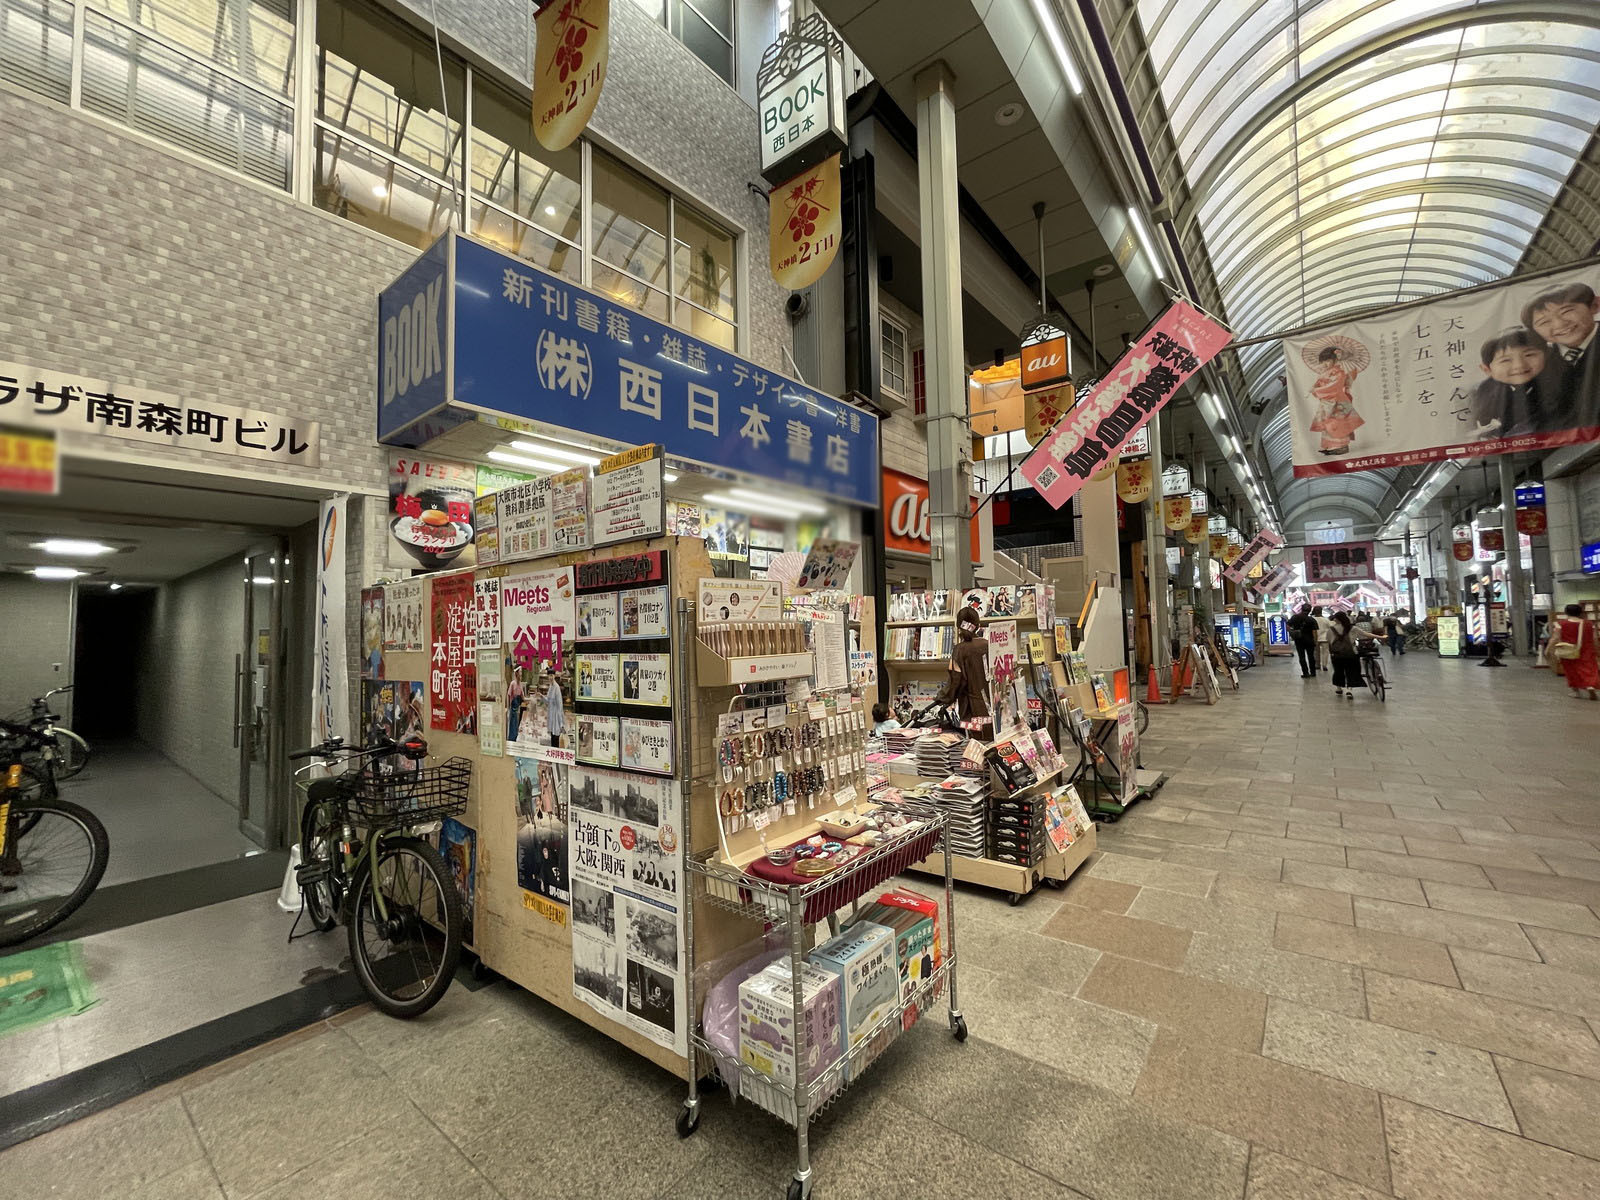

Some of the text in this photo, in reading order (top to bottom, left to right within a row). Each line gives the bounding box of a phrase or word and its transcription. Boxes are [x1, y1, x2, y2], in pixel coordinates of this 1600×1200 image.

[764, 72, 825, 134] BOOK
[773, 114, 815, 152] 西日本
[776, 233, 835, 271] 天神橋2丁目
[384, 274, 442, 406] BOOK
[502, 267, 862, 434] 新刊書籍・雑誌・デザイン書洋書
[1027, 352, 1062, 372] au
[1411, 324, 1438, 418] 七五三を。
[1443, 316, 1472, 423] 天神さんで
[498, 478, 551, 505] 大阪市北区小学校
[505, 494, 546, 517] 教科書準拠版
[423, 546, 445, 554] 2022
[475, 580, 499, 594] 本・雑誌
[579, 554, 652, 586] 新刊発売中
[476, 593, 498, 611] 配達
[504, 584, 549, 607] Meets
[526, 603, 552, 614] Regional
[476, 611, 499, 628] します
[447, 601, 462, 702] 淀屋橋
[513, 625, 565, 672] 谷町
[990, 631, 1009, 643] Meets
[432, 636, 447, 700] 本町
[575, 820, 621, 854] 占領下の
[575, 844, 626, 879] 大阪・関西
